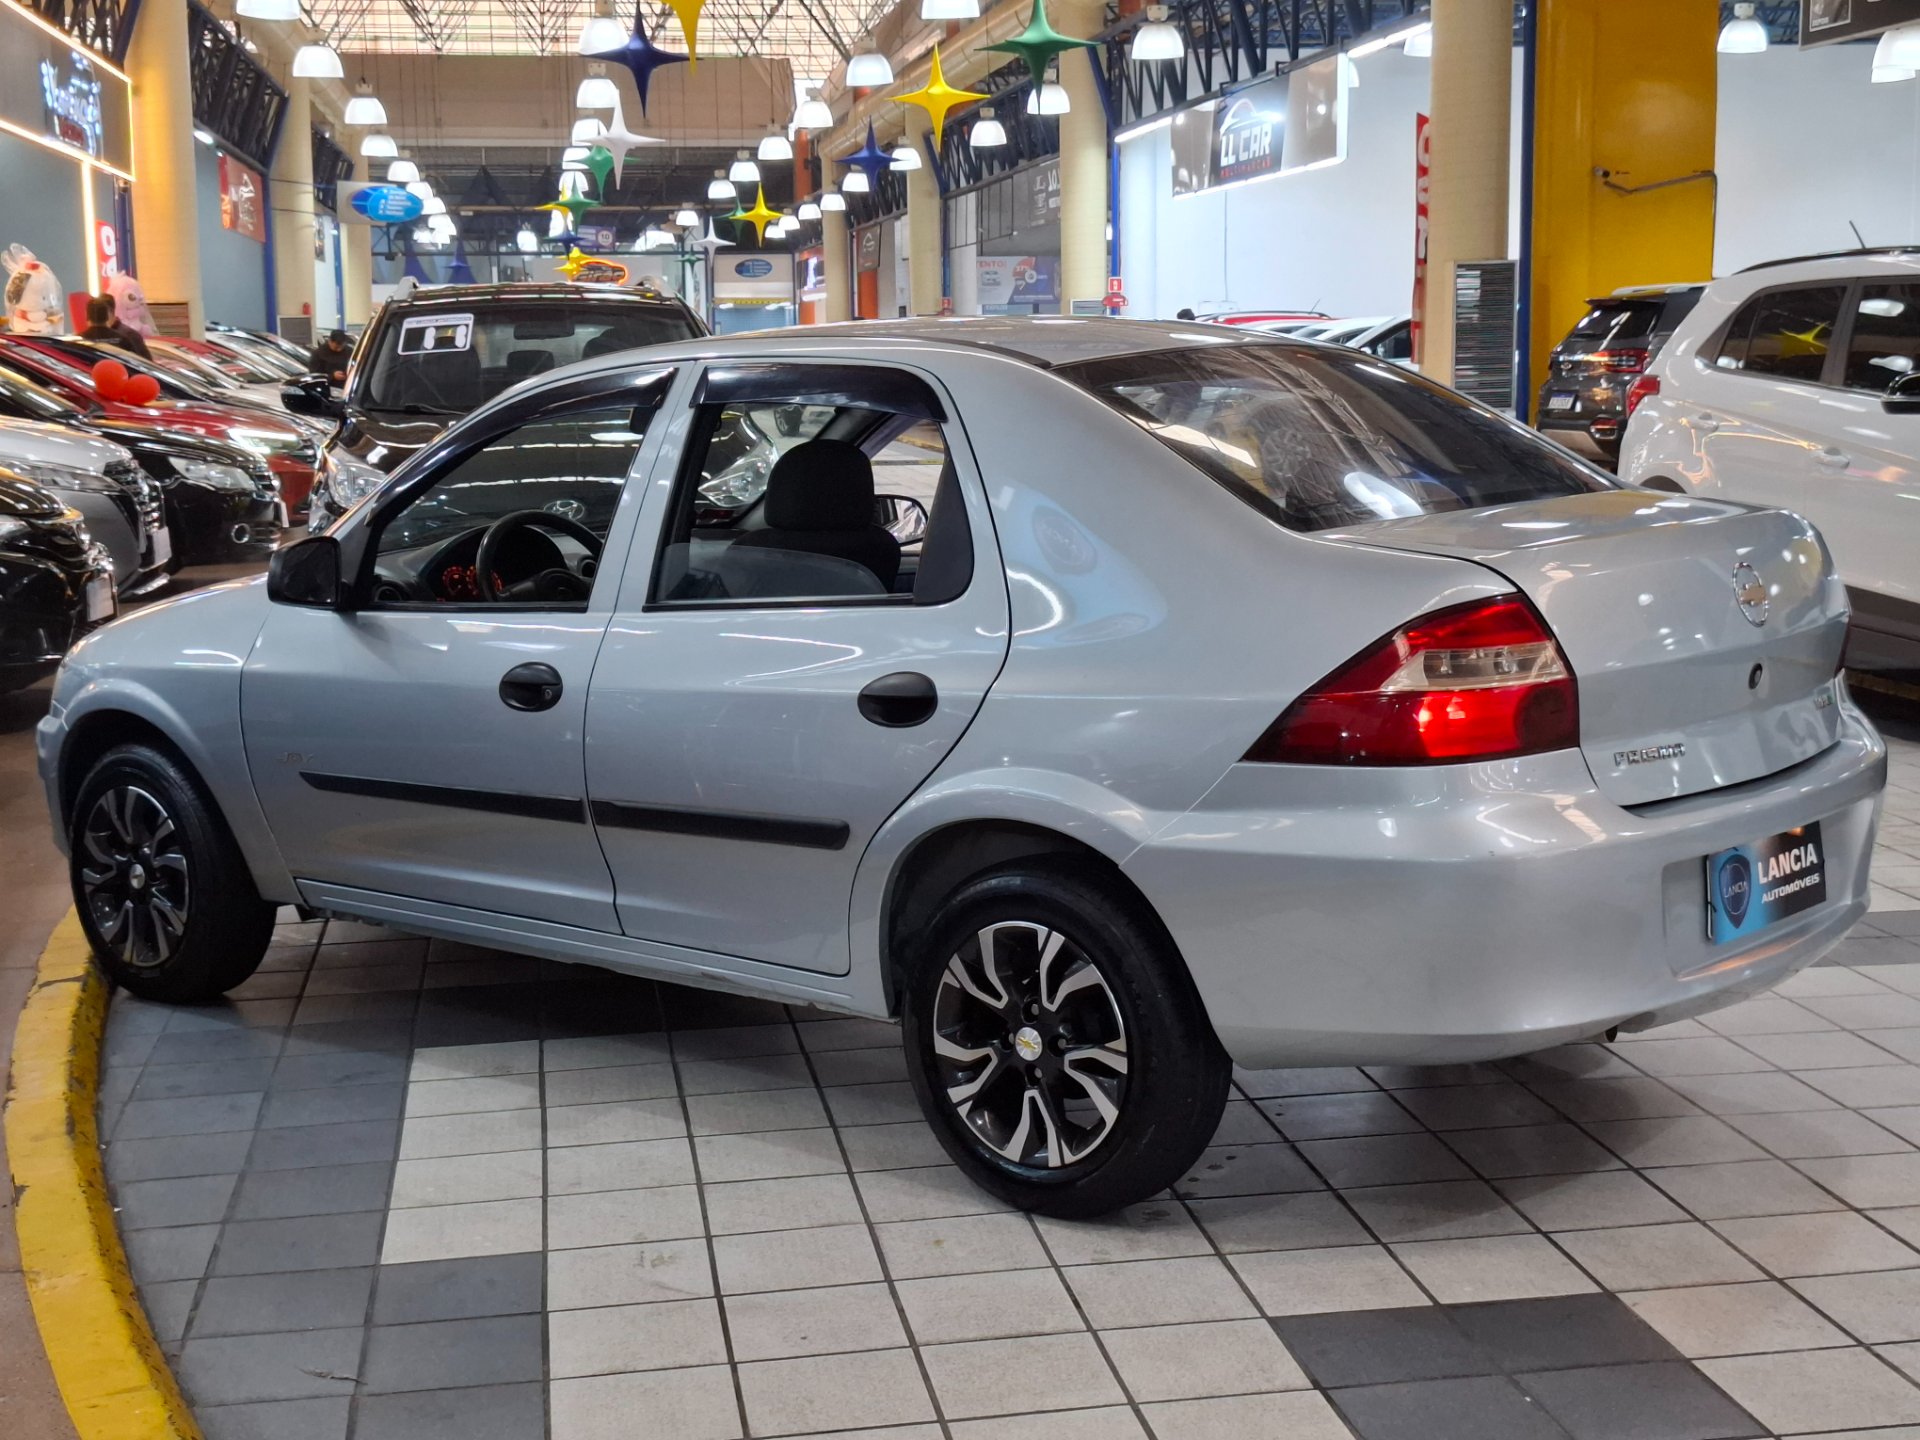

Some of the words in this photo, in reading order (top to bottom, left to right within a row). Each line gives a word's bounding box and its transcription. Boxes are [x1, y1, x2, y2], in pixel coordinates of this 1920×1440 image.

[1220, 133, 1236, 167] LL
[1239, 122, 1273, 161] CAR
[1614, 743, 1686, 767] PRISMA
[1757, 843, 1818, 885] LANCIA
[1723, 880, 1748, 898] LANCIA
[1761, 873, 1820, 905] AUTOMÓVEIS
